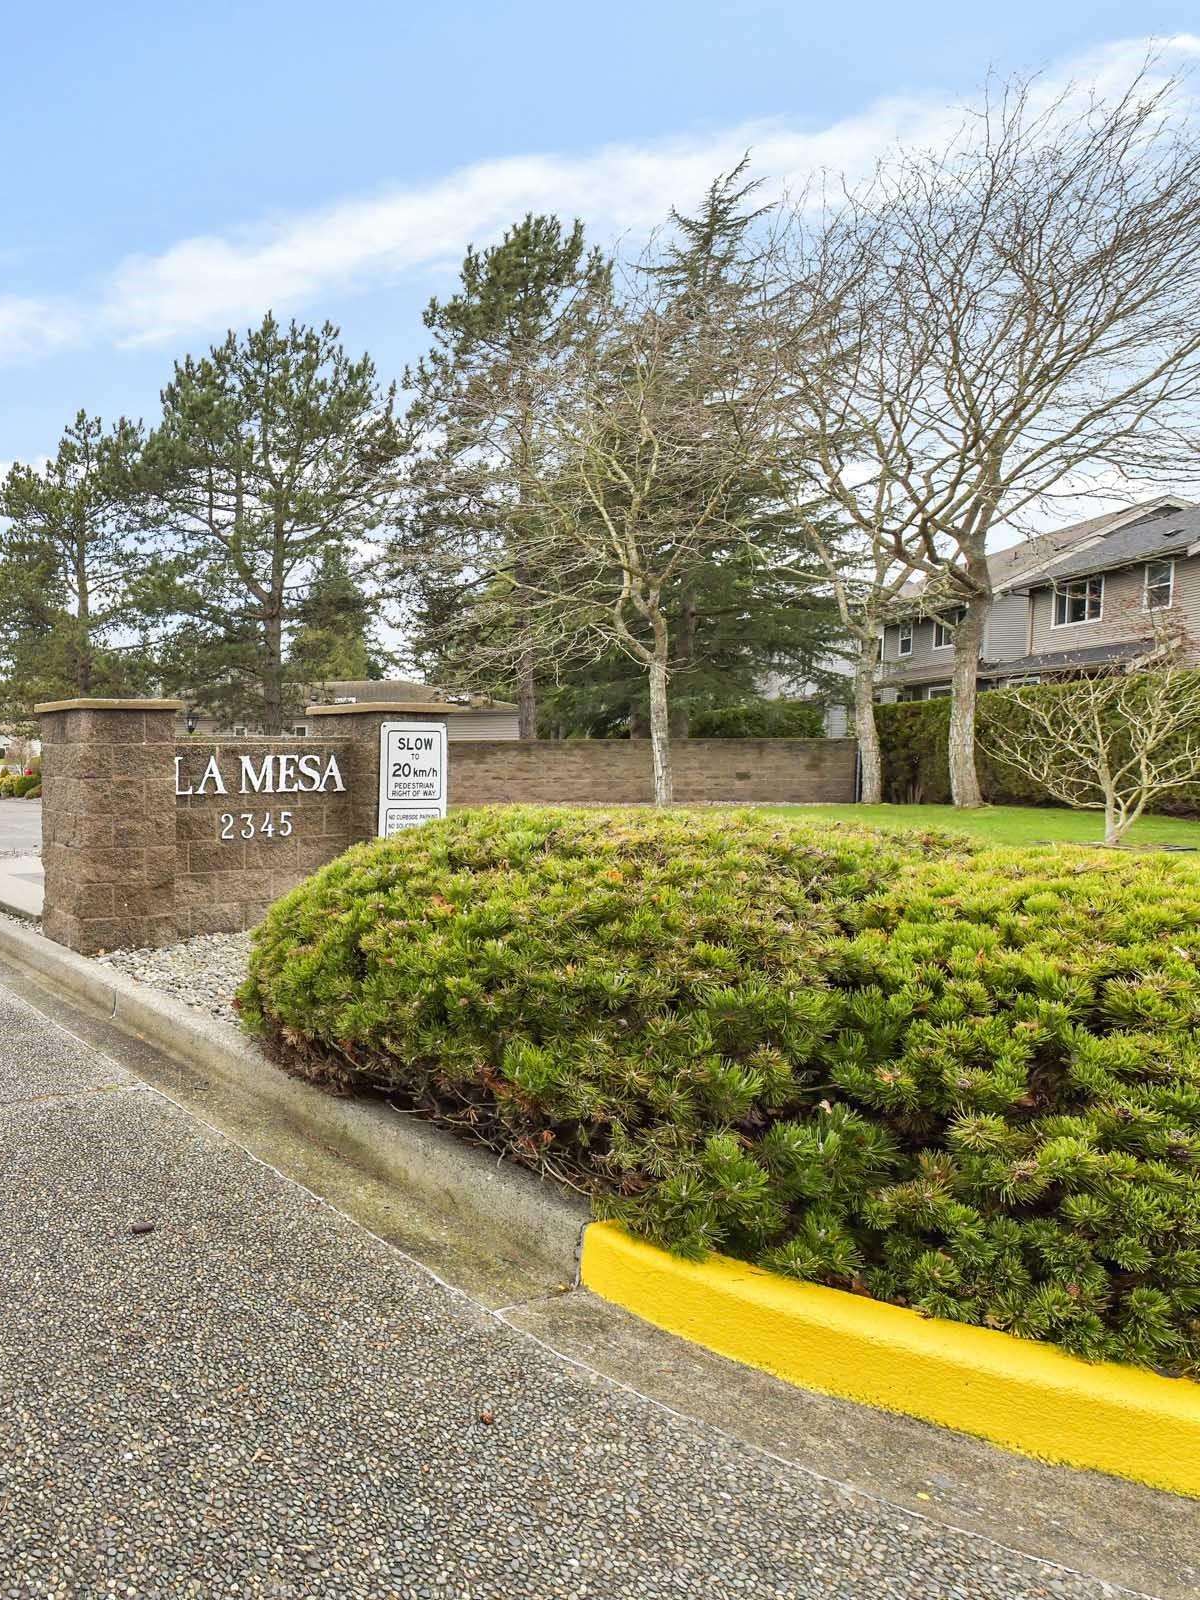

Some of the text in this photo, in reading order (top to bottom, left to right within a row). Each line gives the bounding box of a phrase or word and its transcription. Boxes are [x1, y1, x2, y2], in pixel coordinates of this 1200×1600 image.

[397, 737, 433, 750] SLOW
[174, 754, 347, 795] LA MESA
[392, 763, 438, 777] 20 km/h
[423, 789, 436, 797] WAY
[221, 812, 293, 839] 2345
